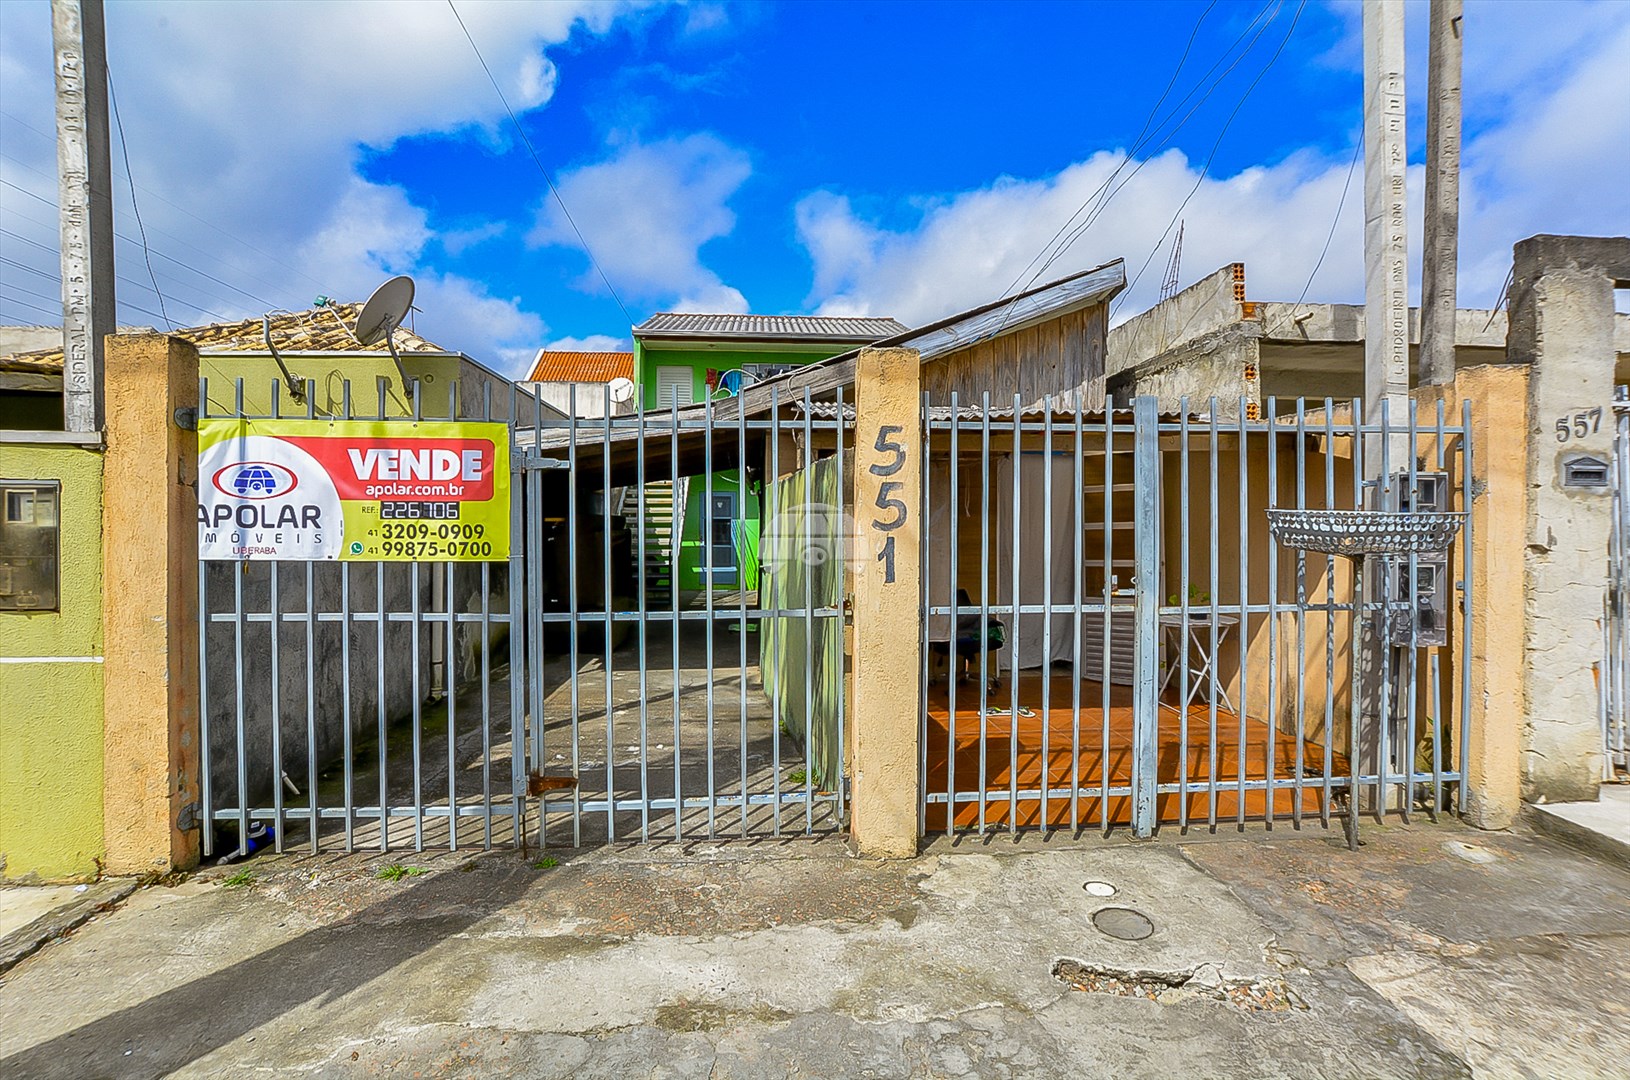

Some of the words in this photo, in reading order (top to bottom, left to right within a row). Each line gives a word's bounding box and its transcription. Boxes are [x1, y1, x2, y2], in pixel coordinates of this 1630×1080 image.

[71, 325, 87, 384] SIDERAL
[1555, 406, 1602, 443] 557
[347, 448, 483, 481] VENDE
[365, 482, 465, 499] apolar.com.br
[381, 501, 459, 519] 226706
[869, 425, 908, 584] 551
[197, 504, 322, 529] APOLAR
[204, 530, 323, 544] MÓVEIS
[367, 529, 379, 537] 41
[381, 523, 485, 540] 3209-0909
[232, 546, 278, 555] UBERABA
[367, 547, 379, 555] 41
[381, 541, 493, 557] 99875-0700
